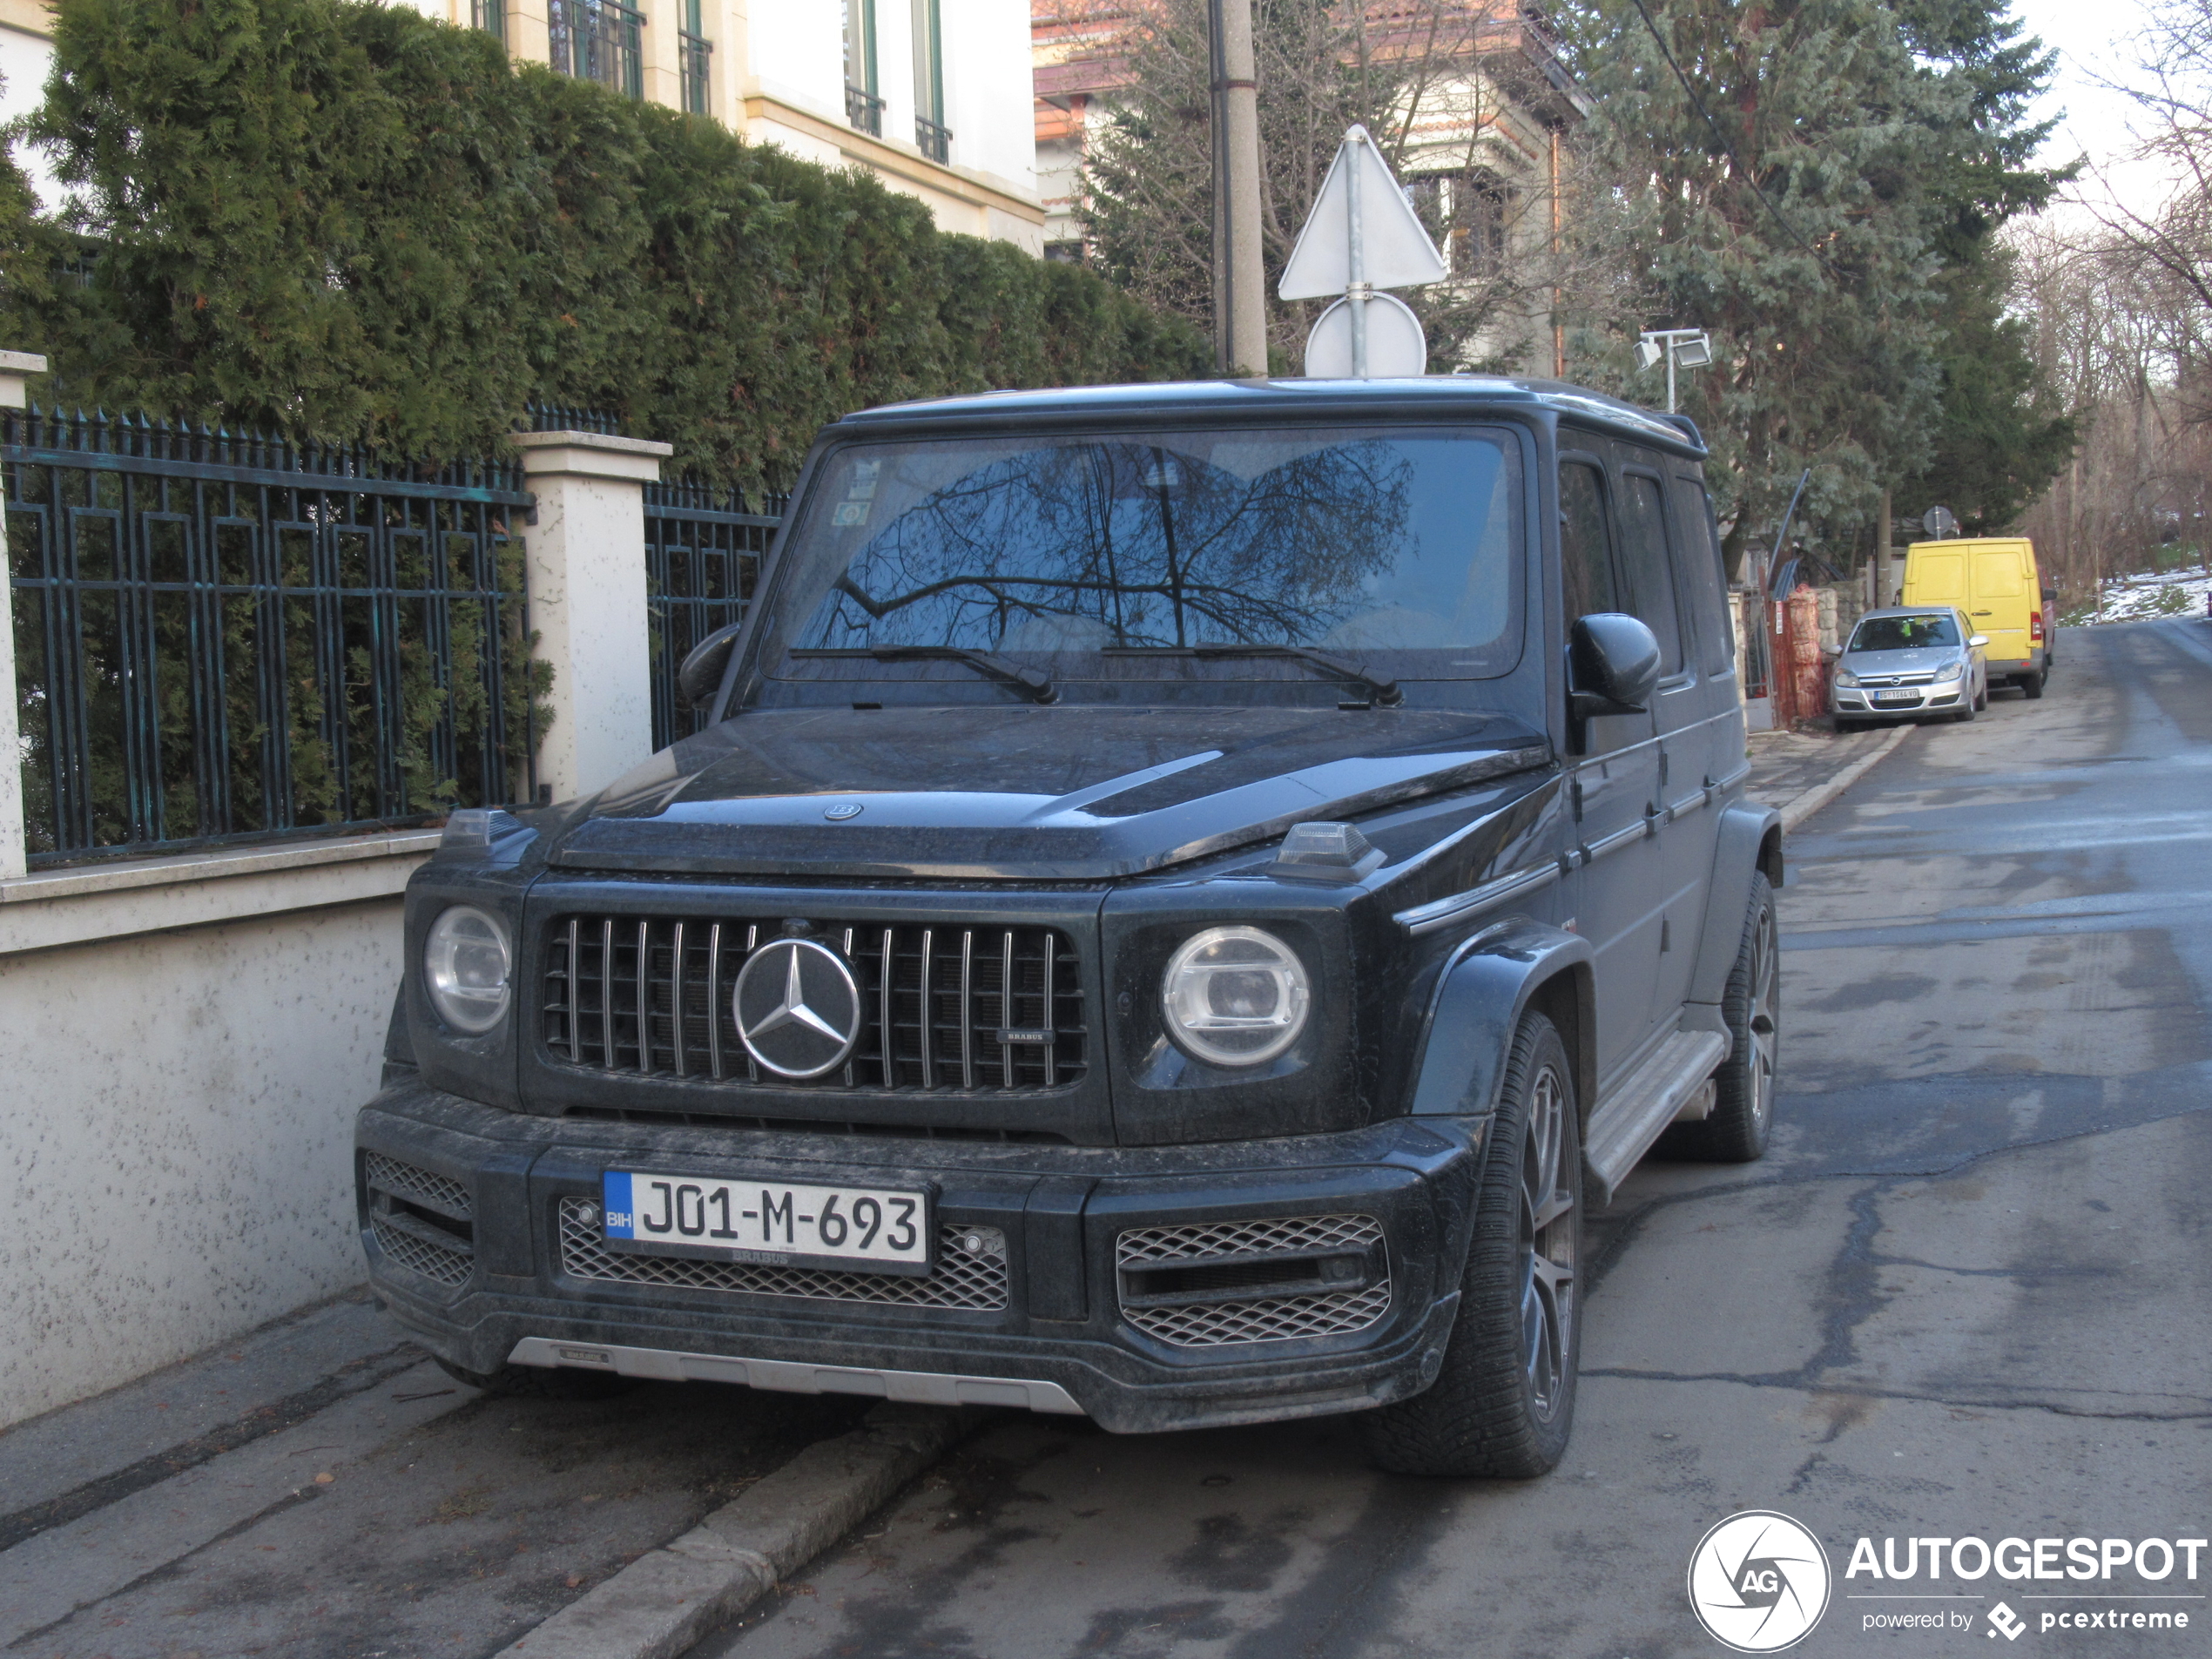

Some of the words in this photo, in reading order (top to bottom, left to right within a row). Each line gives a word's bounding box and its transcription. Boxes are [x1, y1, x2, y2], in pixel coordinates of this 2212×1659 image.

[606, 1211, 632, 1228] BIH
[643, 1181, 917, 1251] J01-M-693
[732, 1250, 789, 1264] BRABUS
